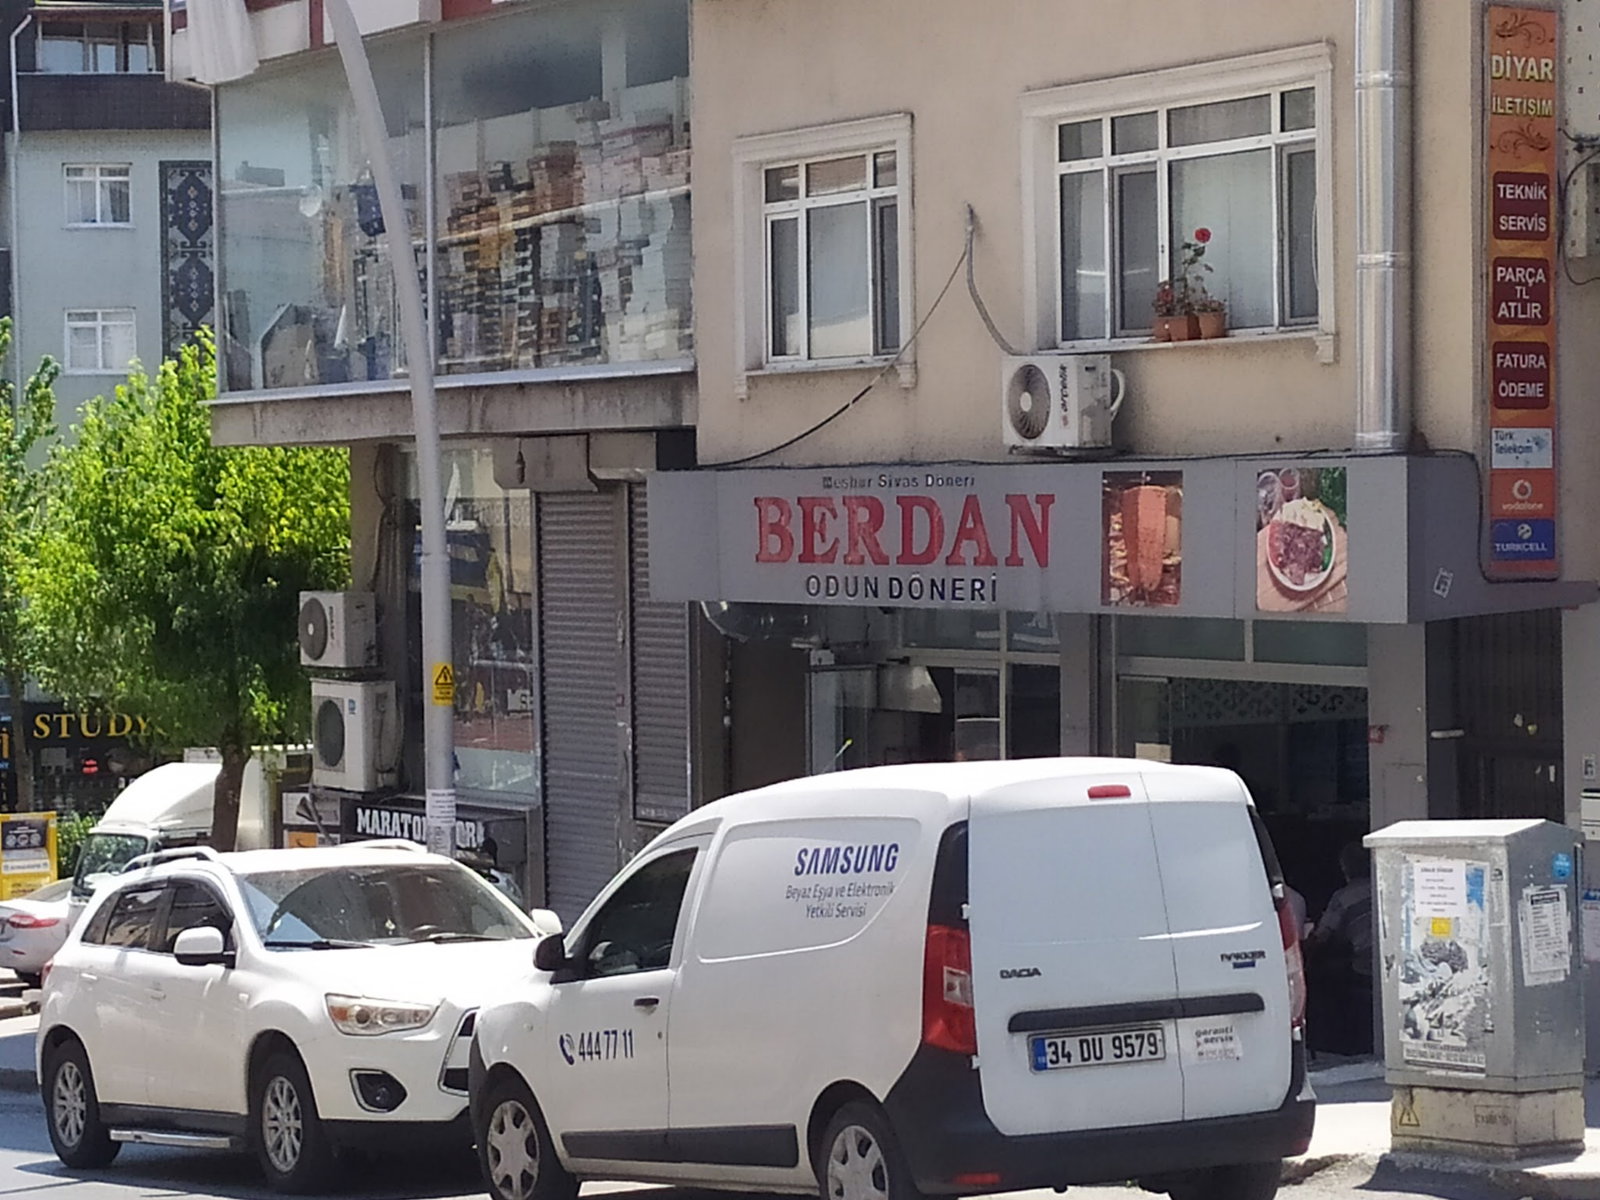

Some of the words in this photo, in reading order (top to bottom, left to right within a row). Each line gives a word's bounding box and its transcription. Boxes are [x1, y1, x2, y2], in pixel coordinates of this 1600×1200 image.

[1491, 50, 1553, 81] DİYAR
[1497, 181, 1548, 200] TEKNİK
[1498, 212, 1548, 232] SERVİS
[1496, 266, 1546, 287] PARÇA
[1496, 353, 1547, 369] FATURA
[1498, 381, 1545, 398] ÖDEME
[1494, 443, 1534, 454] Telekom
[877, 474, 919, 488] Sivas
[753, 494, 1056, 568] BERDAN
[806, 575, 879, 598] ODUN
[888, 572, 998, 602] DÖNERİ
[794, 843, 900, 876] SAMSUNG
[785, 884, 812, 903] Beyaz
[835, 888, 846, 897] ve
[847, 881, 896, 898] Elektronik
[805, 902, 834, 919] Yetkili
[835, 902, 868, 918] Servisi
[578, 1031, 601, 1061] 444
[603, 1029, 618, 1060] 77
[623, 1029, 634, 1058] 11
[1047, 1040, 1072, 1065] 34
[1079, 1037, 1104, 1062] DU
[1112, 1032, 1159, 1059] 9579
